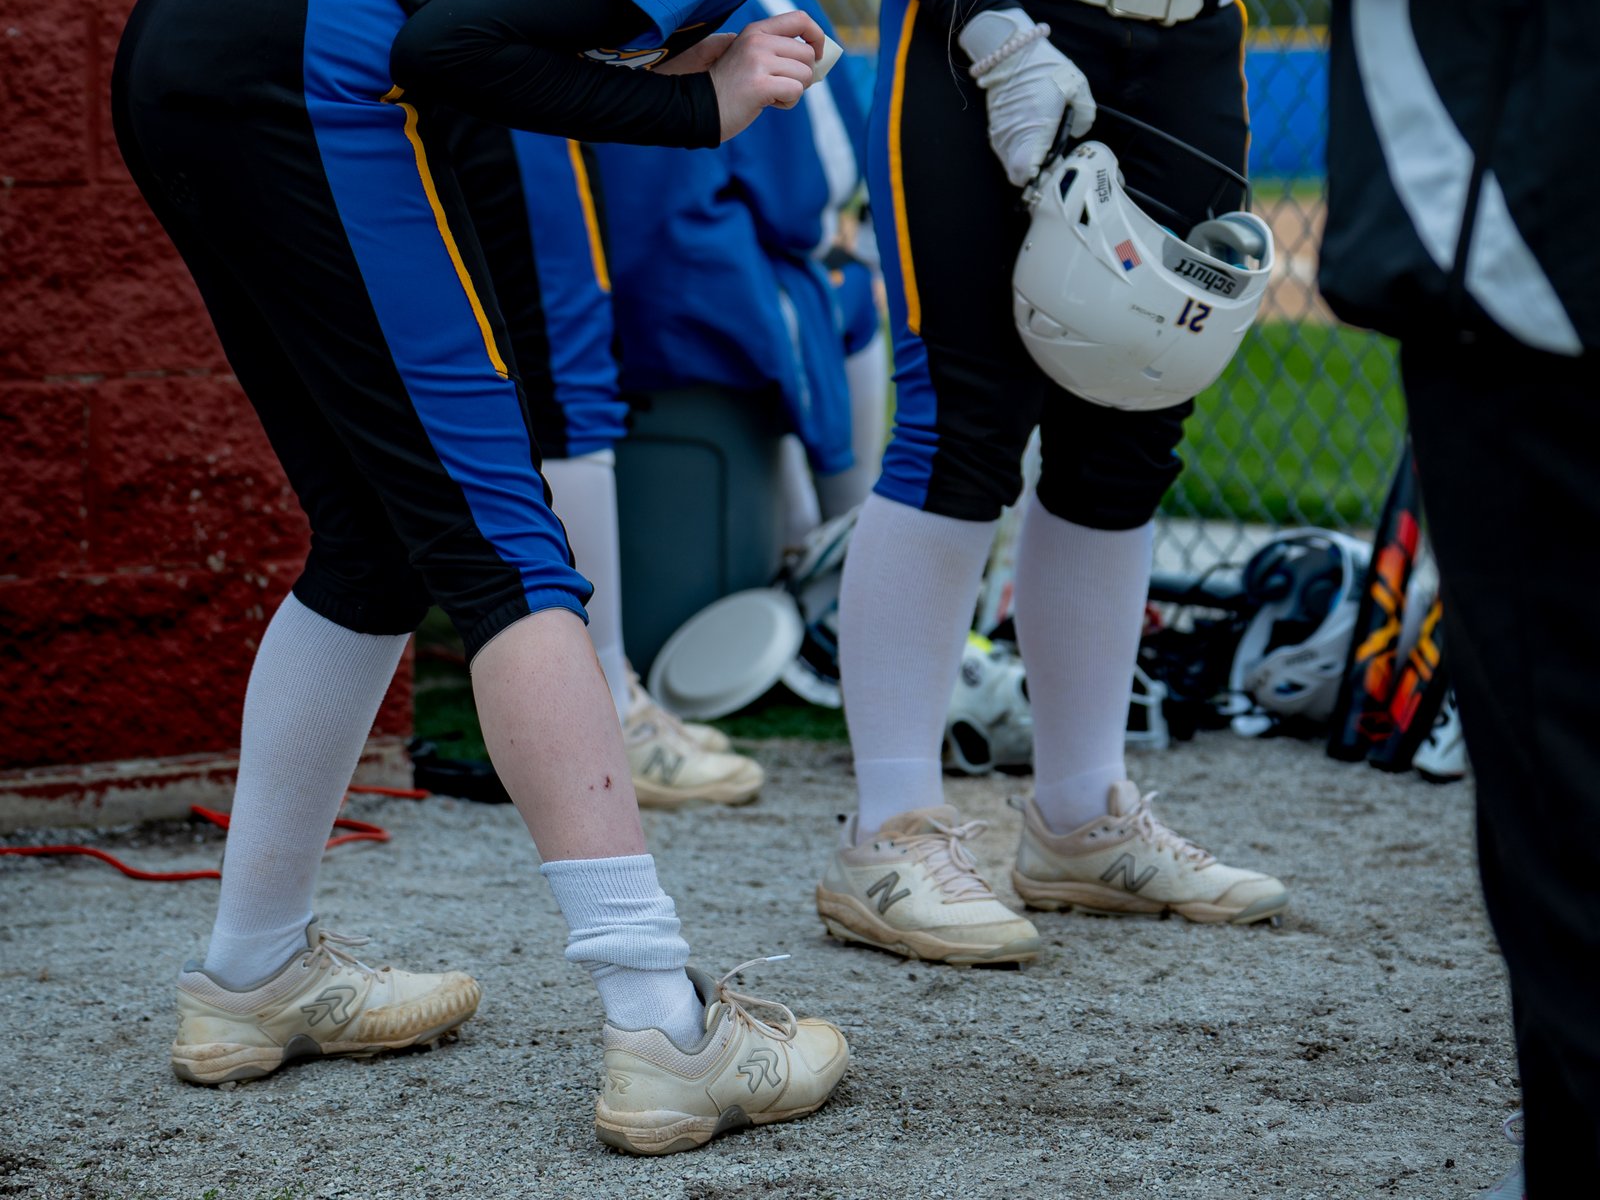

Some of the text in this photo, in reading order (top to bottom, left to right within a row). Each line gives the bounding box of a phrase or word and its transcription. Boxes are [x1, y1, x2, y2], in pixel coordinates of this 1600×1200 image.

[1174, 258, 1236, 295] schutt
[1176, 297, 1211, 334] 21
[1099, 852, 1160, 894] N
